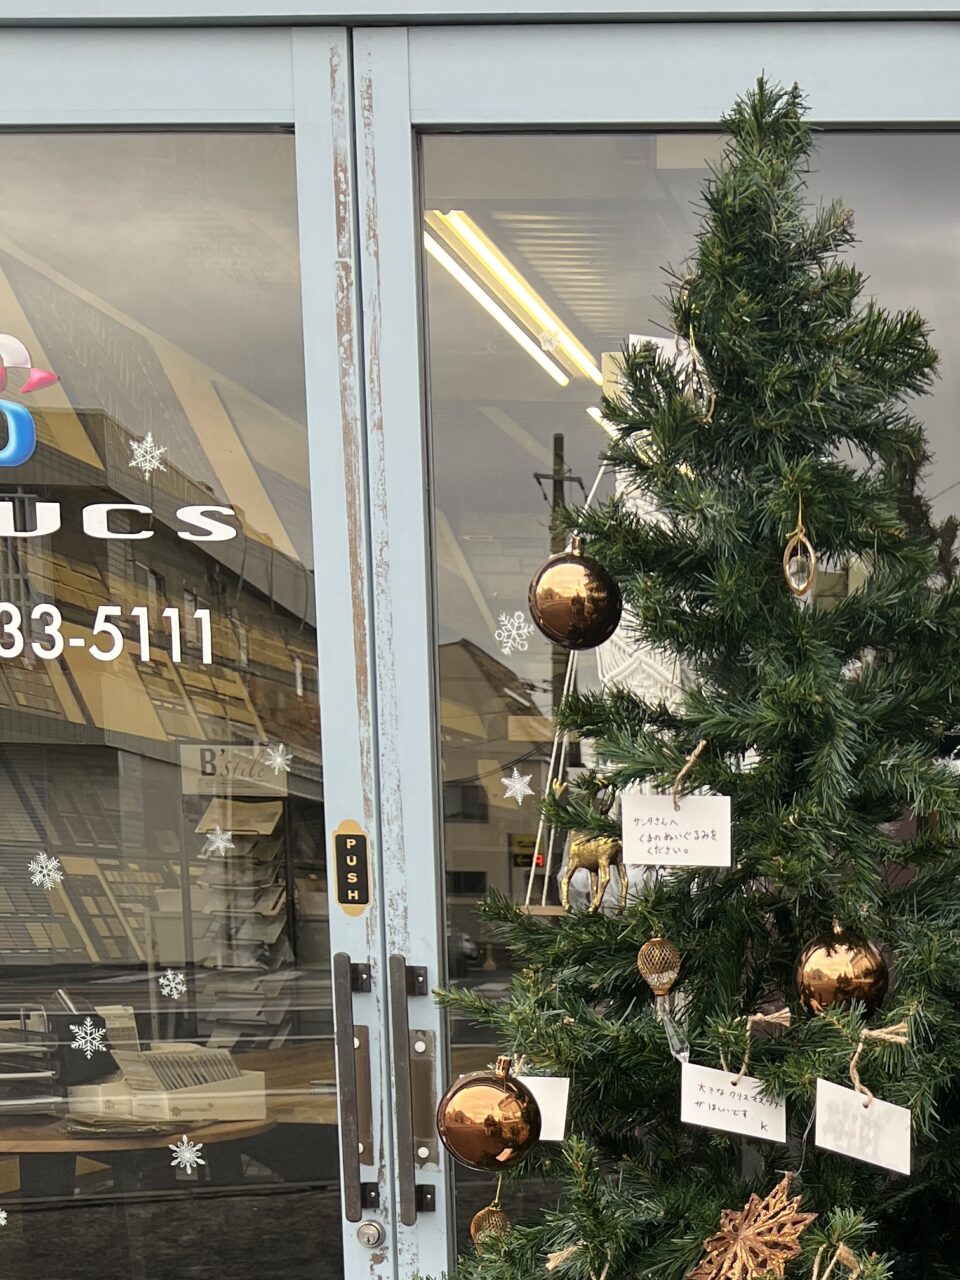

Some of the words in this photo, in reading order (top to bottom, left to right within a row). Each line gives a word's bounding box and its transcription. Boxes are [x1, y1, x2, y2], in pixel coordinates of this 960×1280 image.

[0, 500, 238, 542] UCS
[0, 601, 213, 665] 33-5111
[633, 816, 679, 827] サンタさんへ
[639, 828, 717, 842] くまのぬいぐるみを
[646, 844, 689, 856] ください。
[346, 838, 359, 900] PUSH
